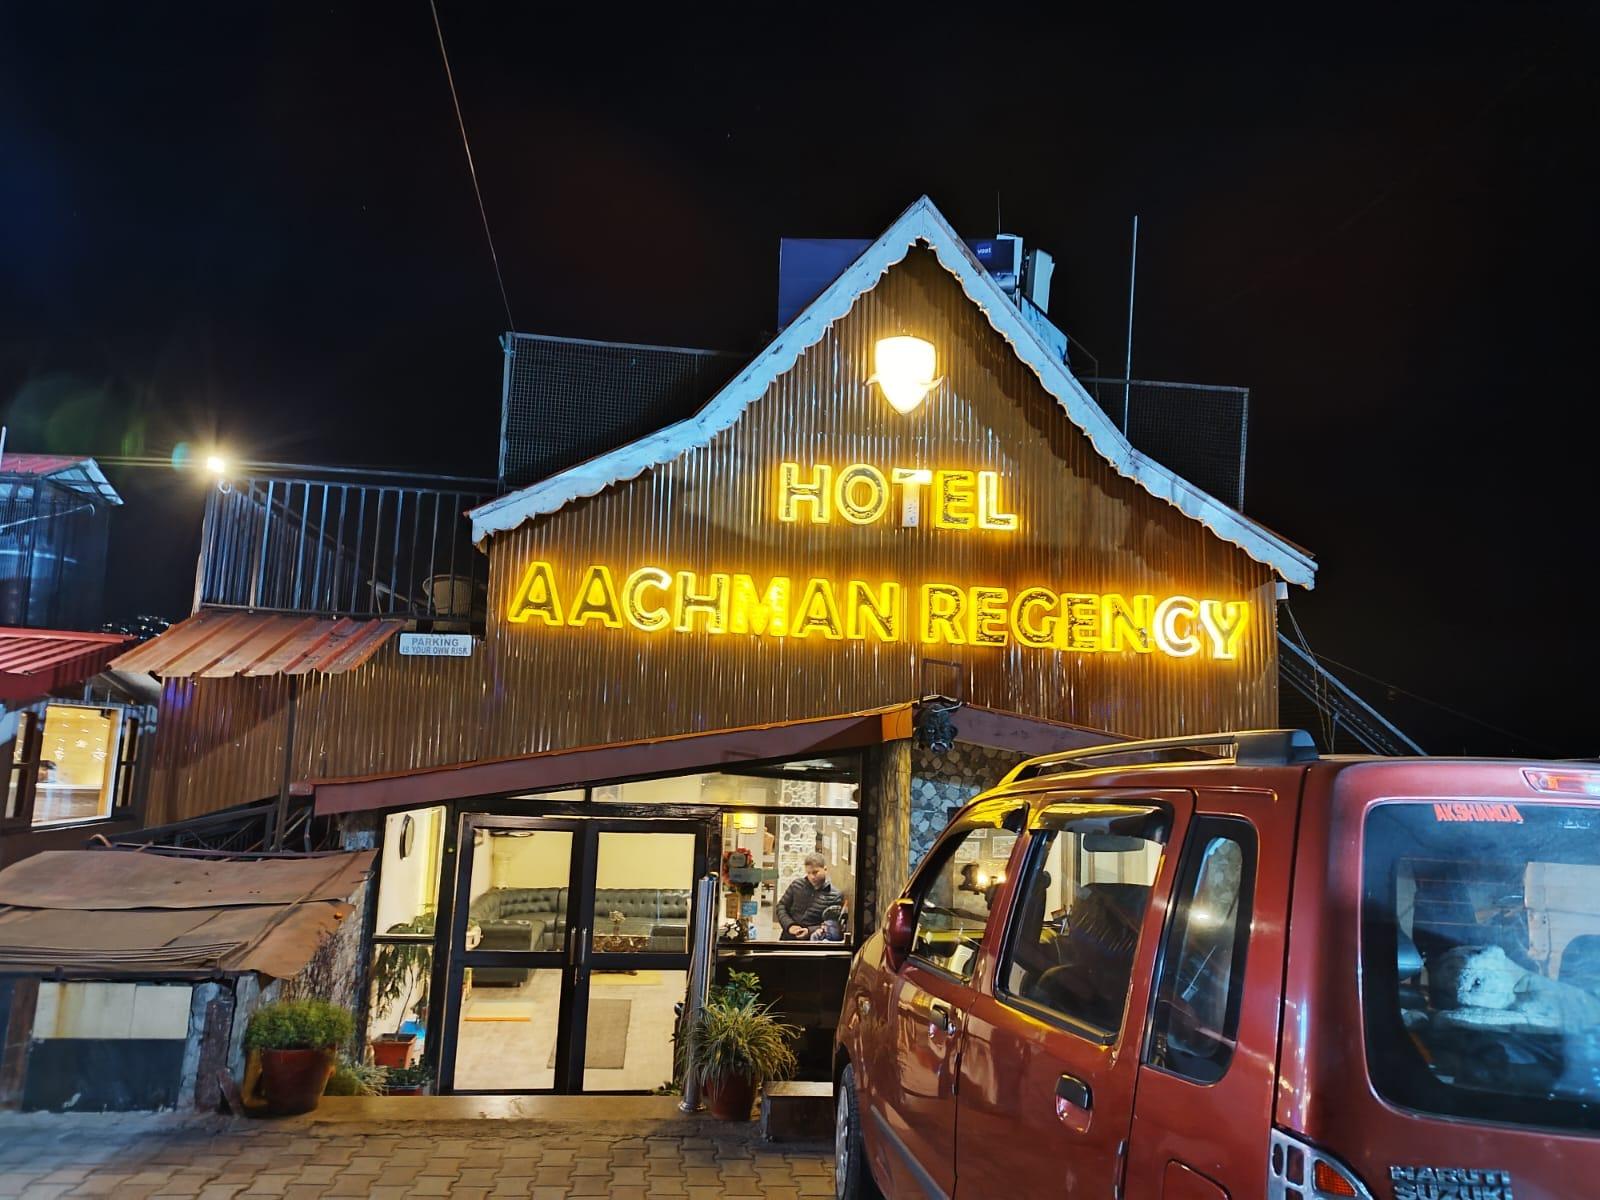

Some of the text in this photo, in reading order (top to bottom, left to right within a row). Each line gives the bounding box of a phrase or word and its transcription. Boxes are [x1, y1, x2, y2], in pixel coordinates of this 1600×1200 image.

[778, 462, 1018, 530] HOTEL
[507, 561, 1250, 660] AACHMAN REGENCY
[412, 637, 459, 647] PARKING
[412, 646, 431, 654] YOUR
[451, 647, 468, 655] RISK
[1390, 1166, 1511, 1185] MARUTI
[1393, 1182, 1513, 1200] SUZUKI
